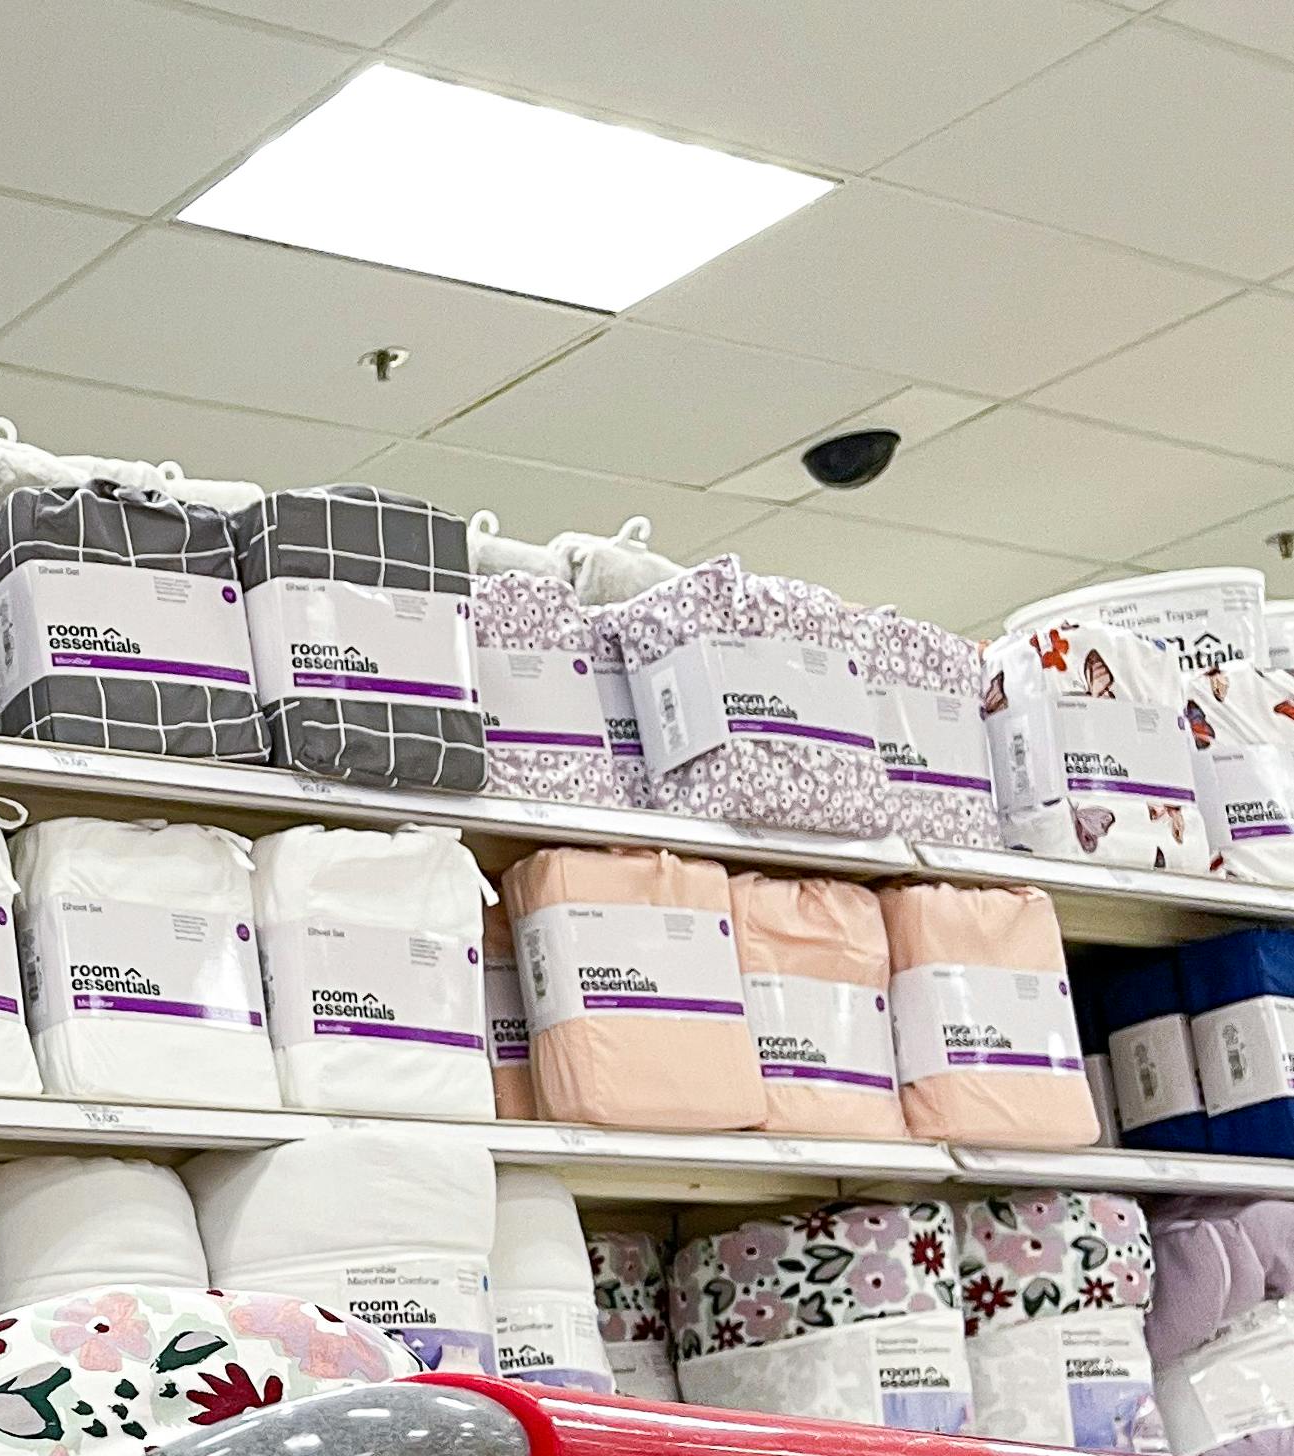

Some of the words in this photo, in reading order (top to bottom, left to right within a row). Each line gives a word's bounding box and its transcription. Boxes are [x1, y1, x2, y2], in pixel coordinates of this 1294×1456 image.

[47, 623, 98, 638] room
[49, 636, 141, 655] essentials
[290, 642, 339, 658] room
[291, 655, 380, 675] essentials
[70, 964, 120, 979] room
[578, 966, 622, 979] room
[71, 976, 161, 996] essentials
[580, 977, 659, 993] essentials
[312, 989, 358, 1004] room
[312, 1001, 396, 1021] essentials
[349, 1299, 399, 1312] room
